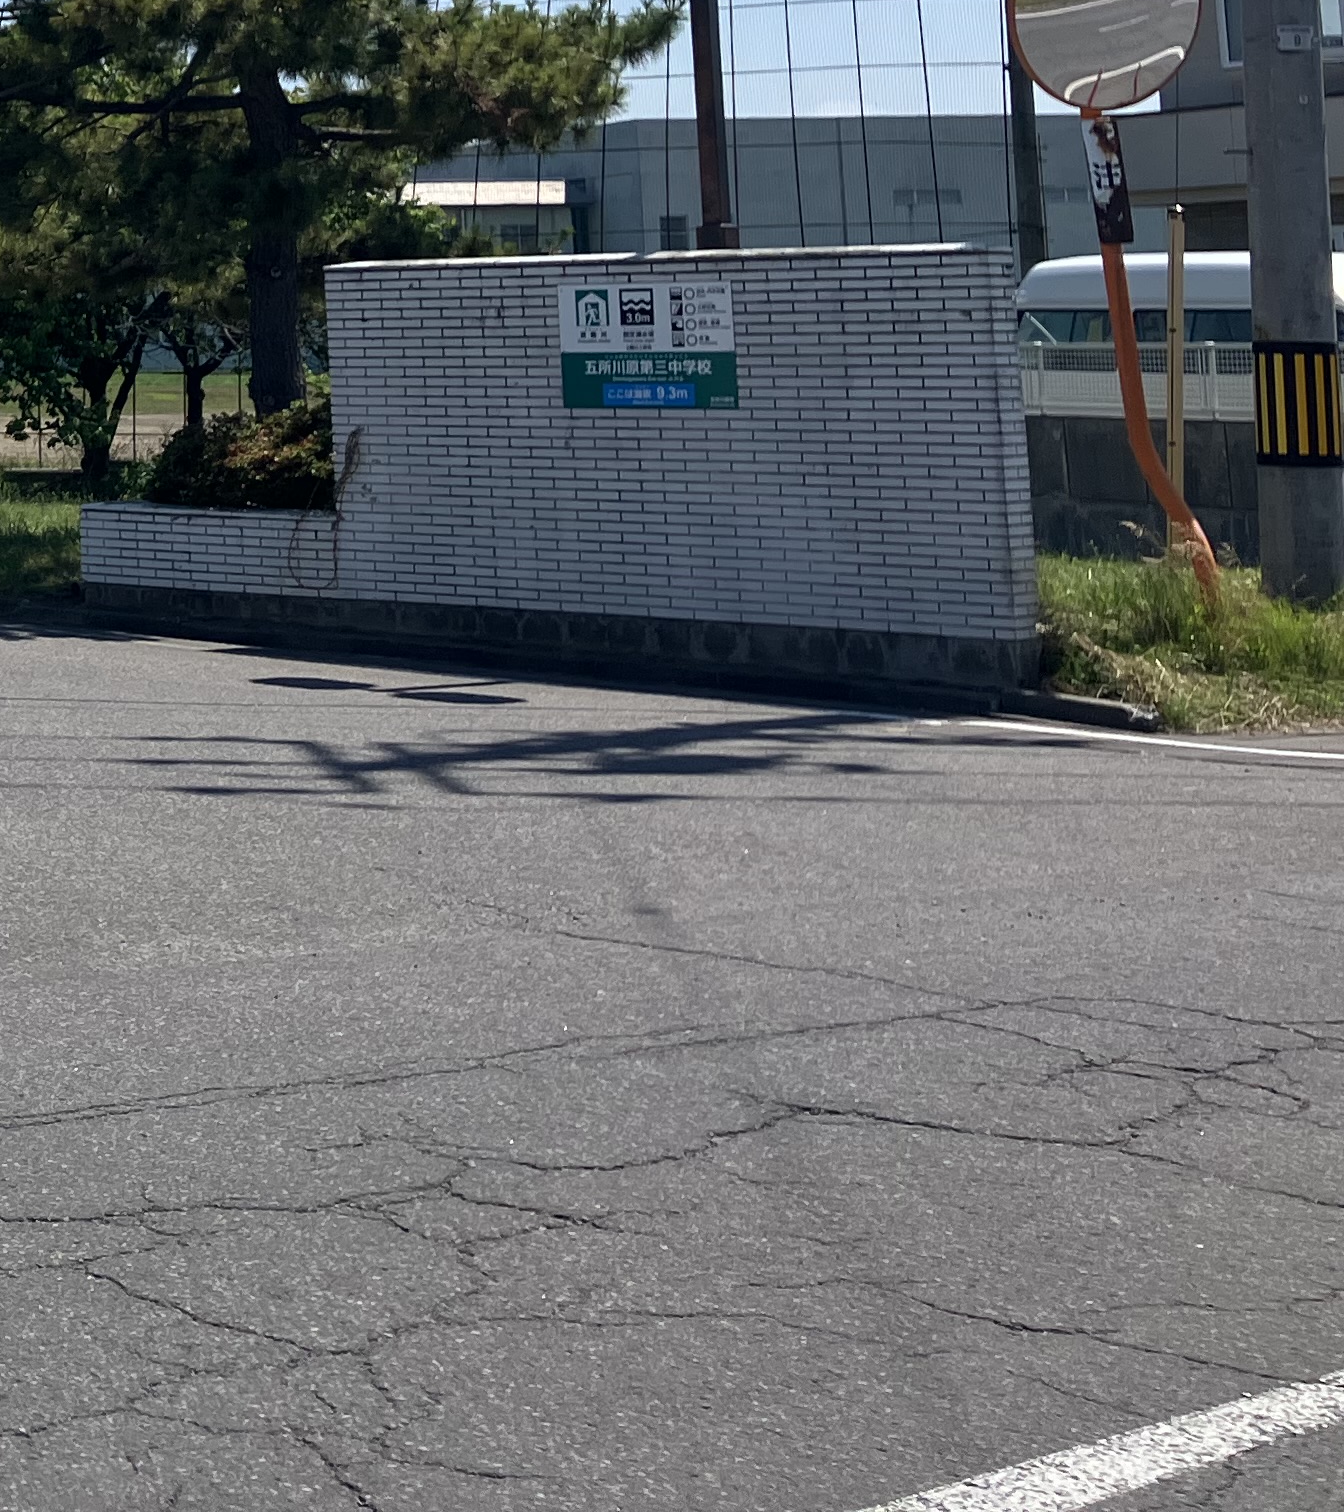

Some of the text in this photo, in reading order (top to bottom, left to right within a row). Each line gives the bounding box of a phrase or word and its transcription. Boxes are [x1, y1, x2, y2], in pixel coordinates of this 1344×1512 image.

[626, 313, 650, 324] 3.0m
[585, 359, 712, 376] 五所川原第三中学校
